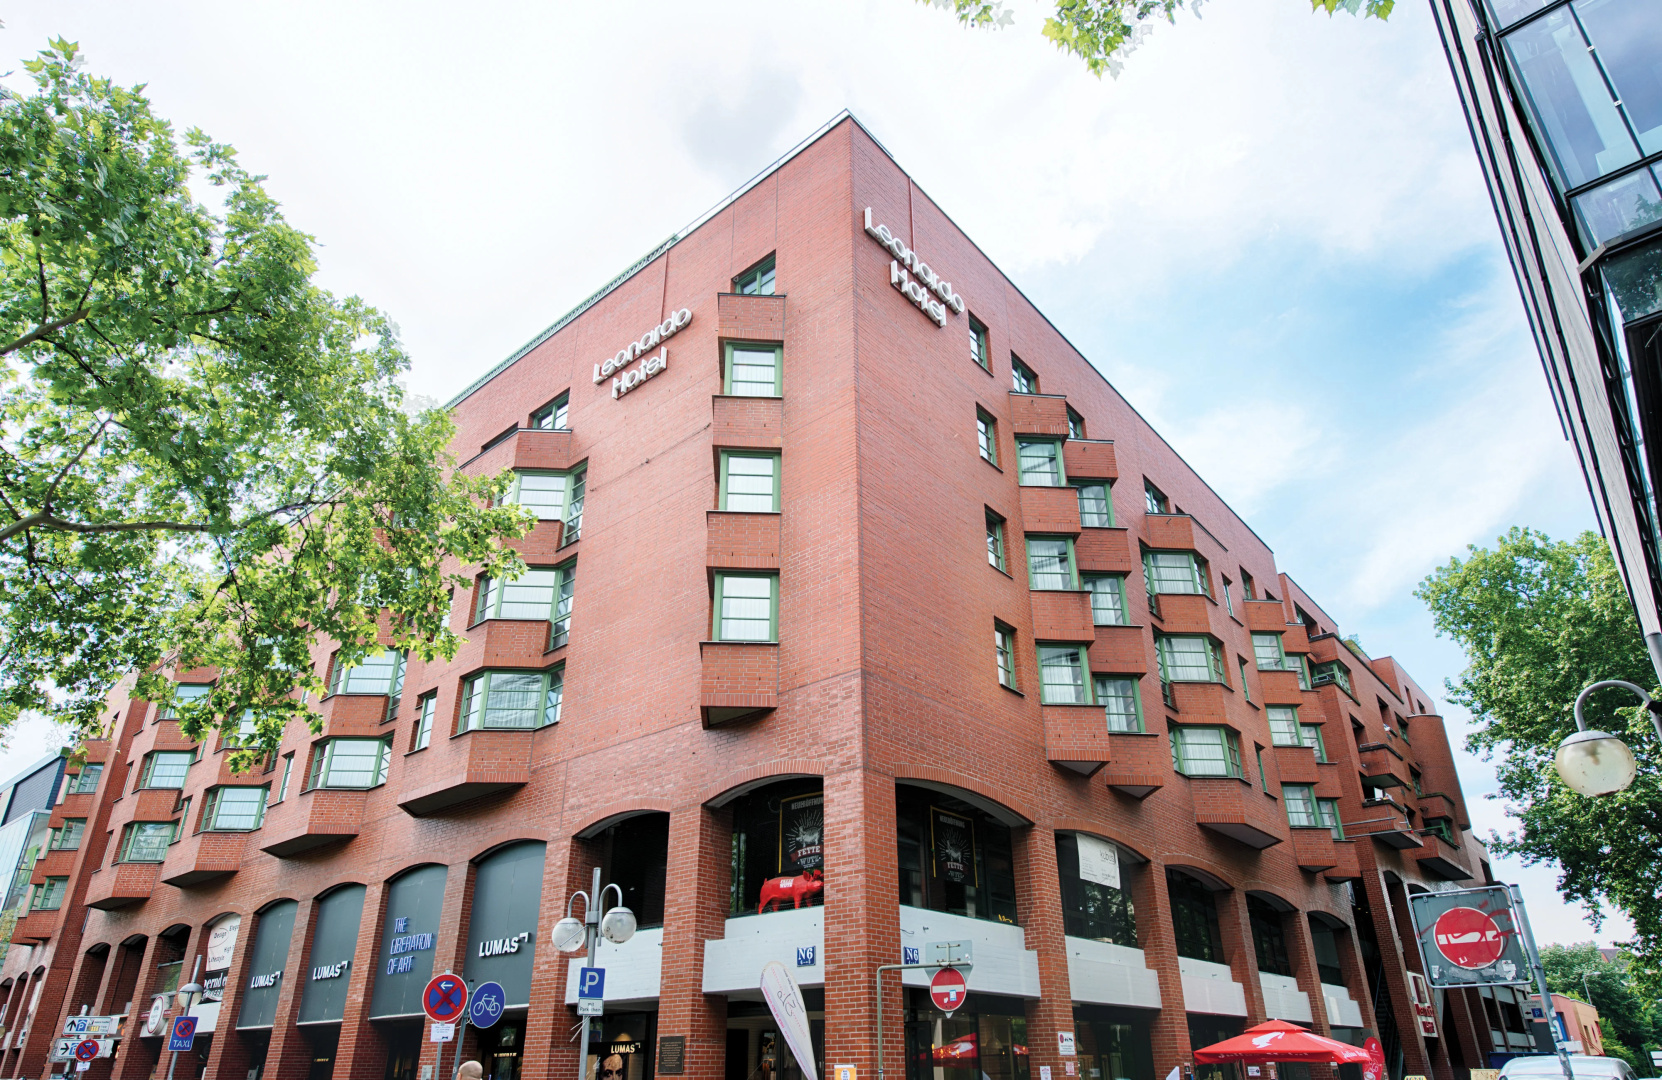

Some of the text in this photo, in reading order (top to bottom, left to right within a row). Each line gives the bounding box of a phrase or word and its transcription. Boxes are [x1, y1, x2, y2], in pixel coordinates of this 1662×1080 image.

[864, 207, 964, 313] Leonardo
[890, 260, 946, 327] Hotel
[593, 307, 693, 385] Leonardo
[611, 346, 668, 399] Hotel
[797, 845, 820, 857] FETTE
[394, 916, 408, 933] THE
[390, 933, 434, 955] LIBERATION
[479, 936, 519, 958] LUMAS
[798, 947, 814, 960] N6
[906, 948, 919, 961] N6
[312, 964, 341, 980] LUMAS
[386, 955, 414, 975] OF ART
[250, 974, 275, 988] LUMAS
[585, 972, 599, 994] P
[173, 1039, 190, 1048] TAXI
[610, 1043, 636, 1054] LUMAS
